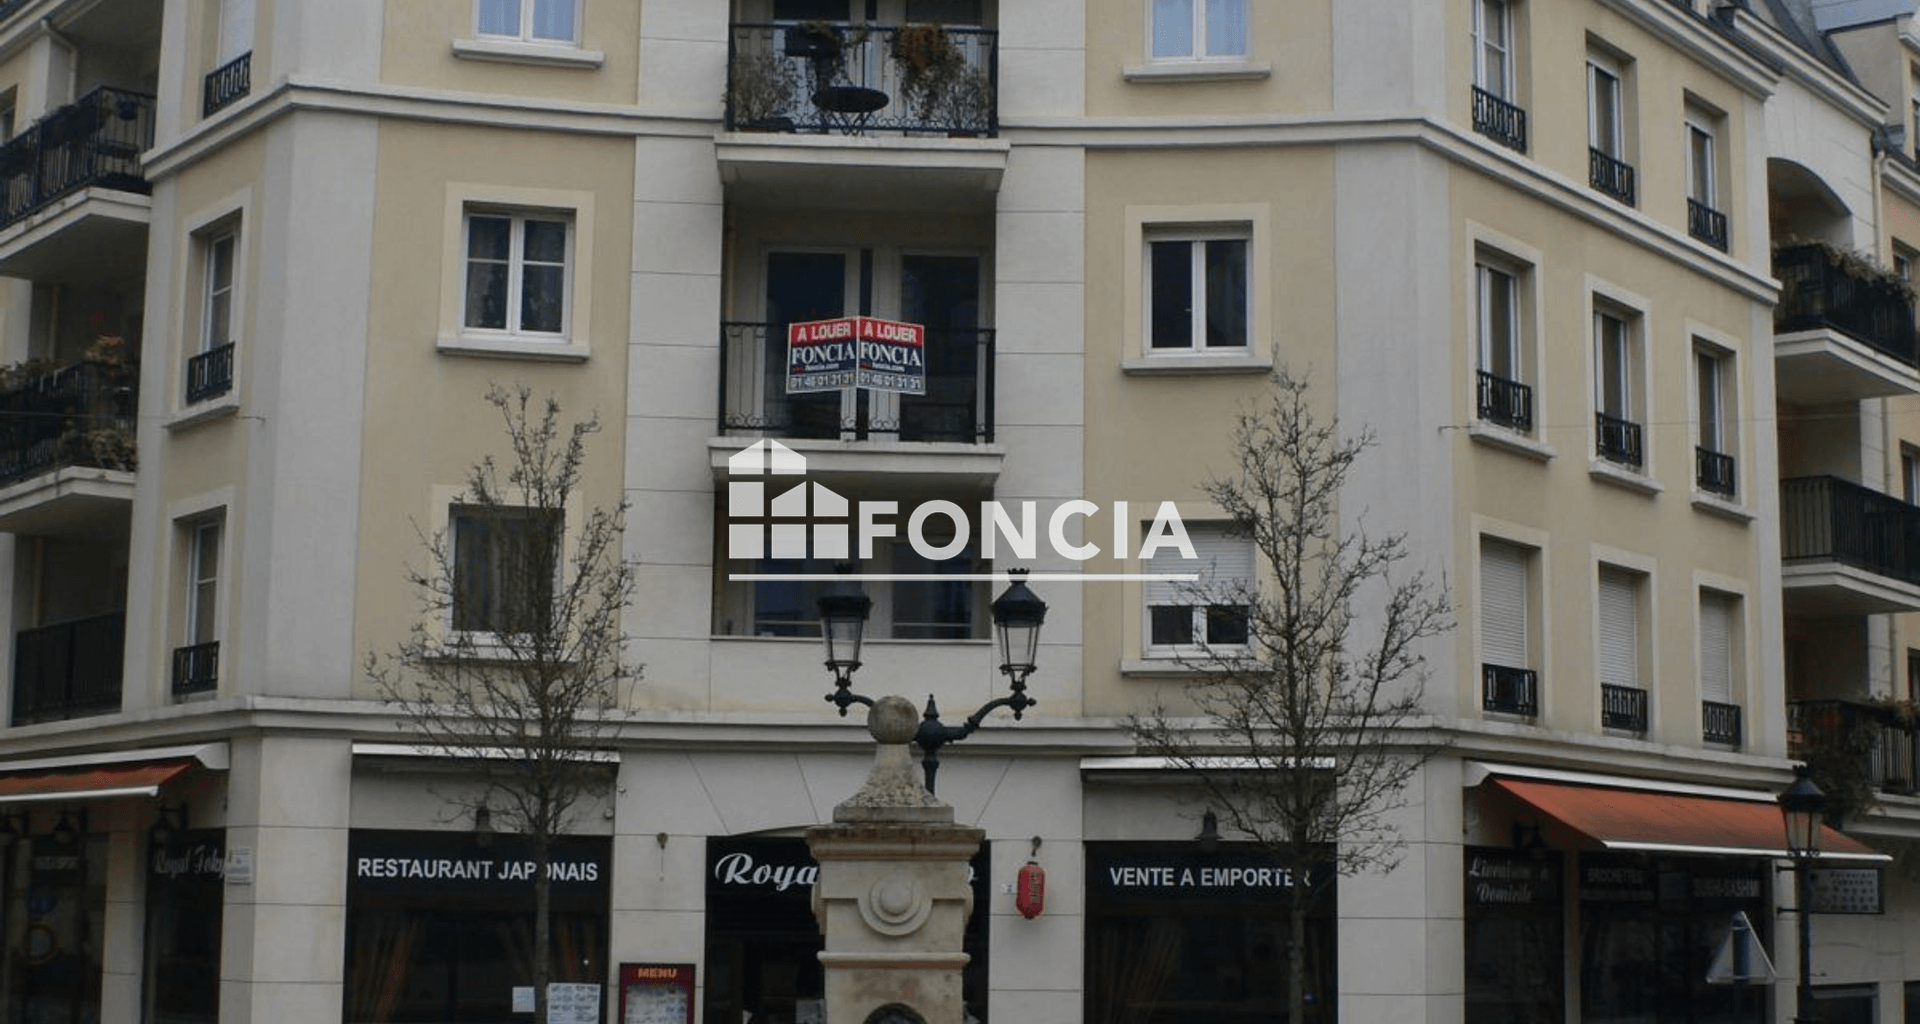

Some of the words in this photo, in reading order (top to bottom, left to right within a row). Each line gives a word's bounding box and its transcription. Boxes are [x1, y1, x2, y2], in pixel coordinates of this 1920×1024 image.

[797, 326, 807, 342] A
[811, 322, 851, 340] LOUER
[864, 321, 873, 337] A
[877, 323, 917, 343] LOUER
[791, 342, 855, 365] FONCIA
[860, 340, 922, 367] FONCIA
[190, 844, 225, 879] Toky
[358, 857, 493, 880] RESTAURANT
[715, 852, 820, 891] Roya
[1110, 867, 1175, 887] VENTE
[1179, 867, 1196, 887] A
[637, 967, 677, 979] MENU
